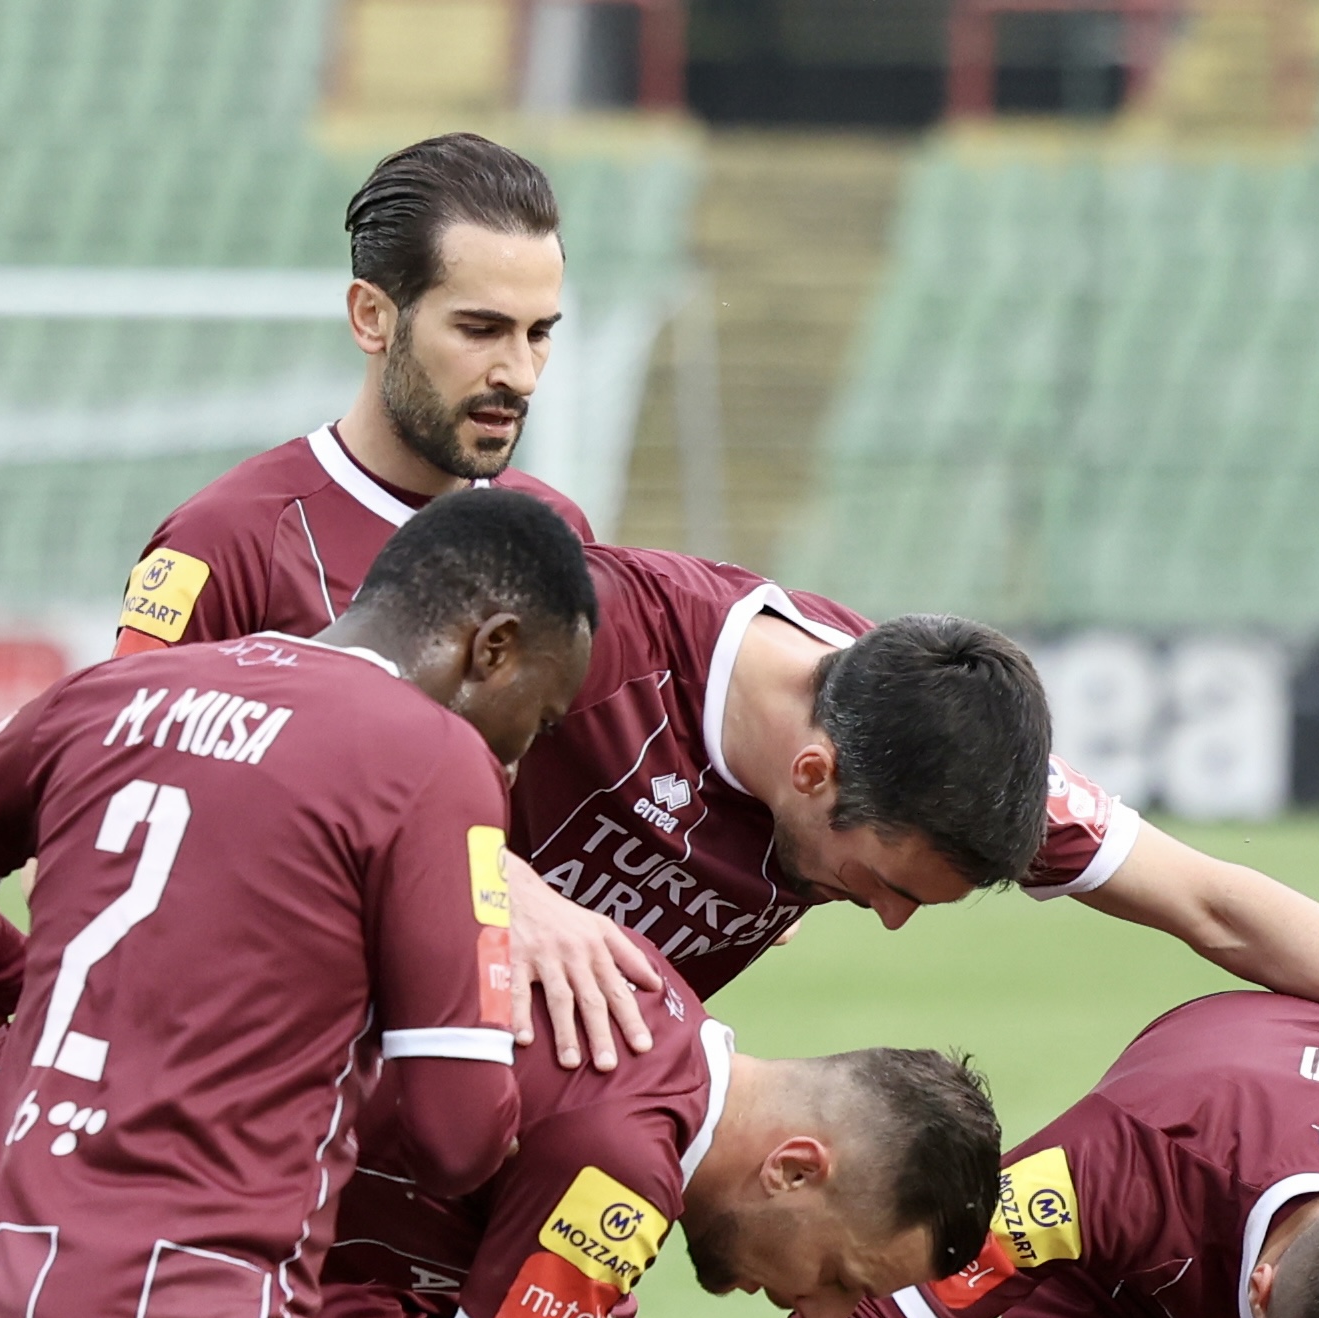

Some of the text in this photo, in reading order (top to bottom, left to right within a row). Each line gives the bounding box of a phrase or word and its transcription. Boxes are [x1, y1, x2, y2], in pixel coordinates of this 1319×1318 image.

[152, 687, 294, 765] MUSA
[633, 797, 679, 834] errea
[30, 778, 192, 1082] 2
[996, 1173, 1038, 1260] MOZZART
